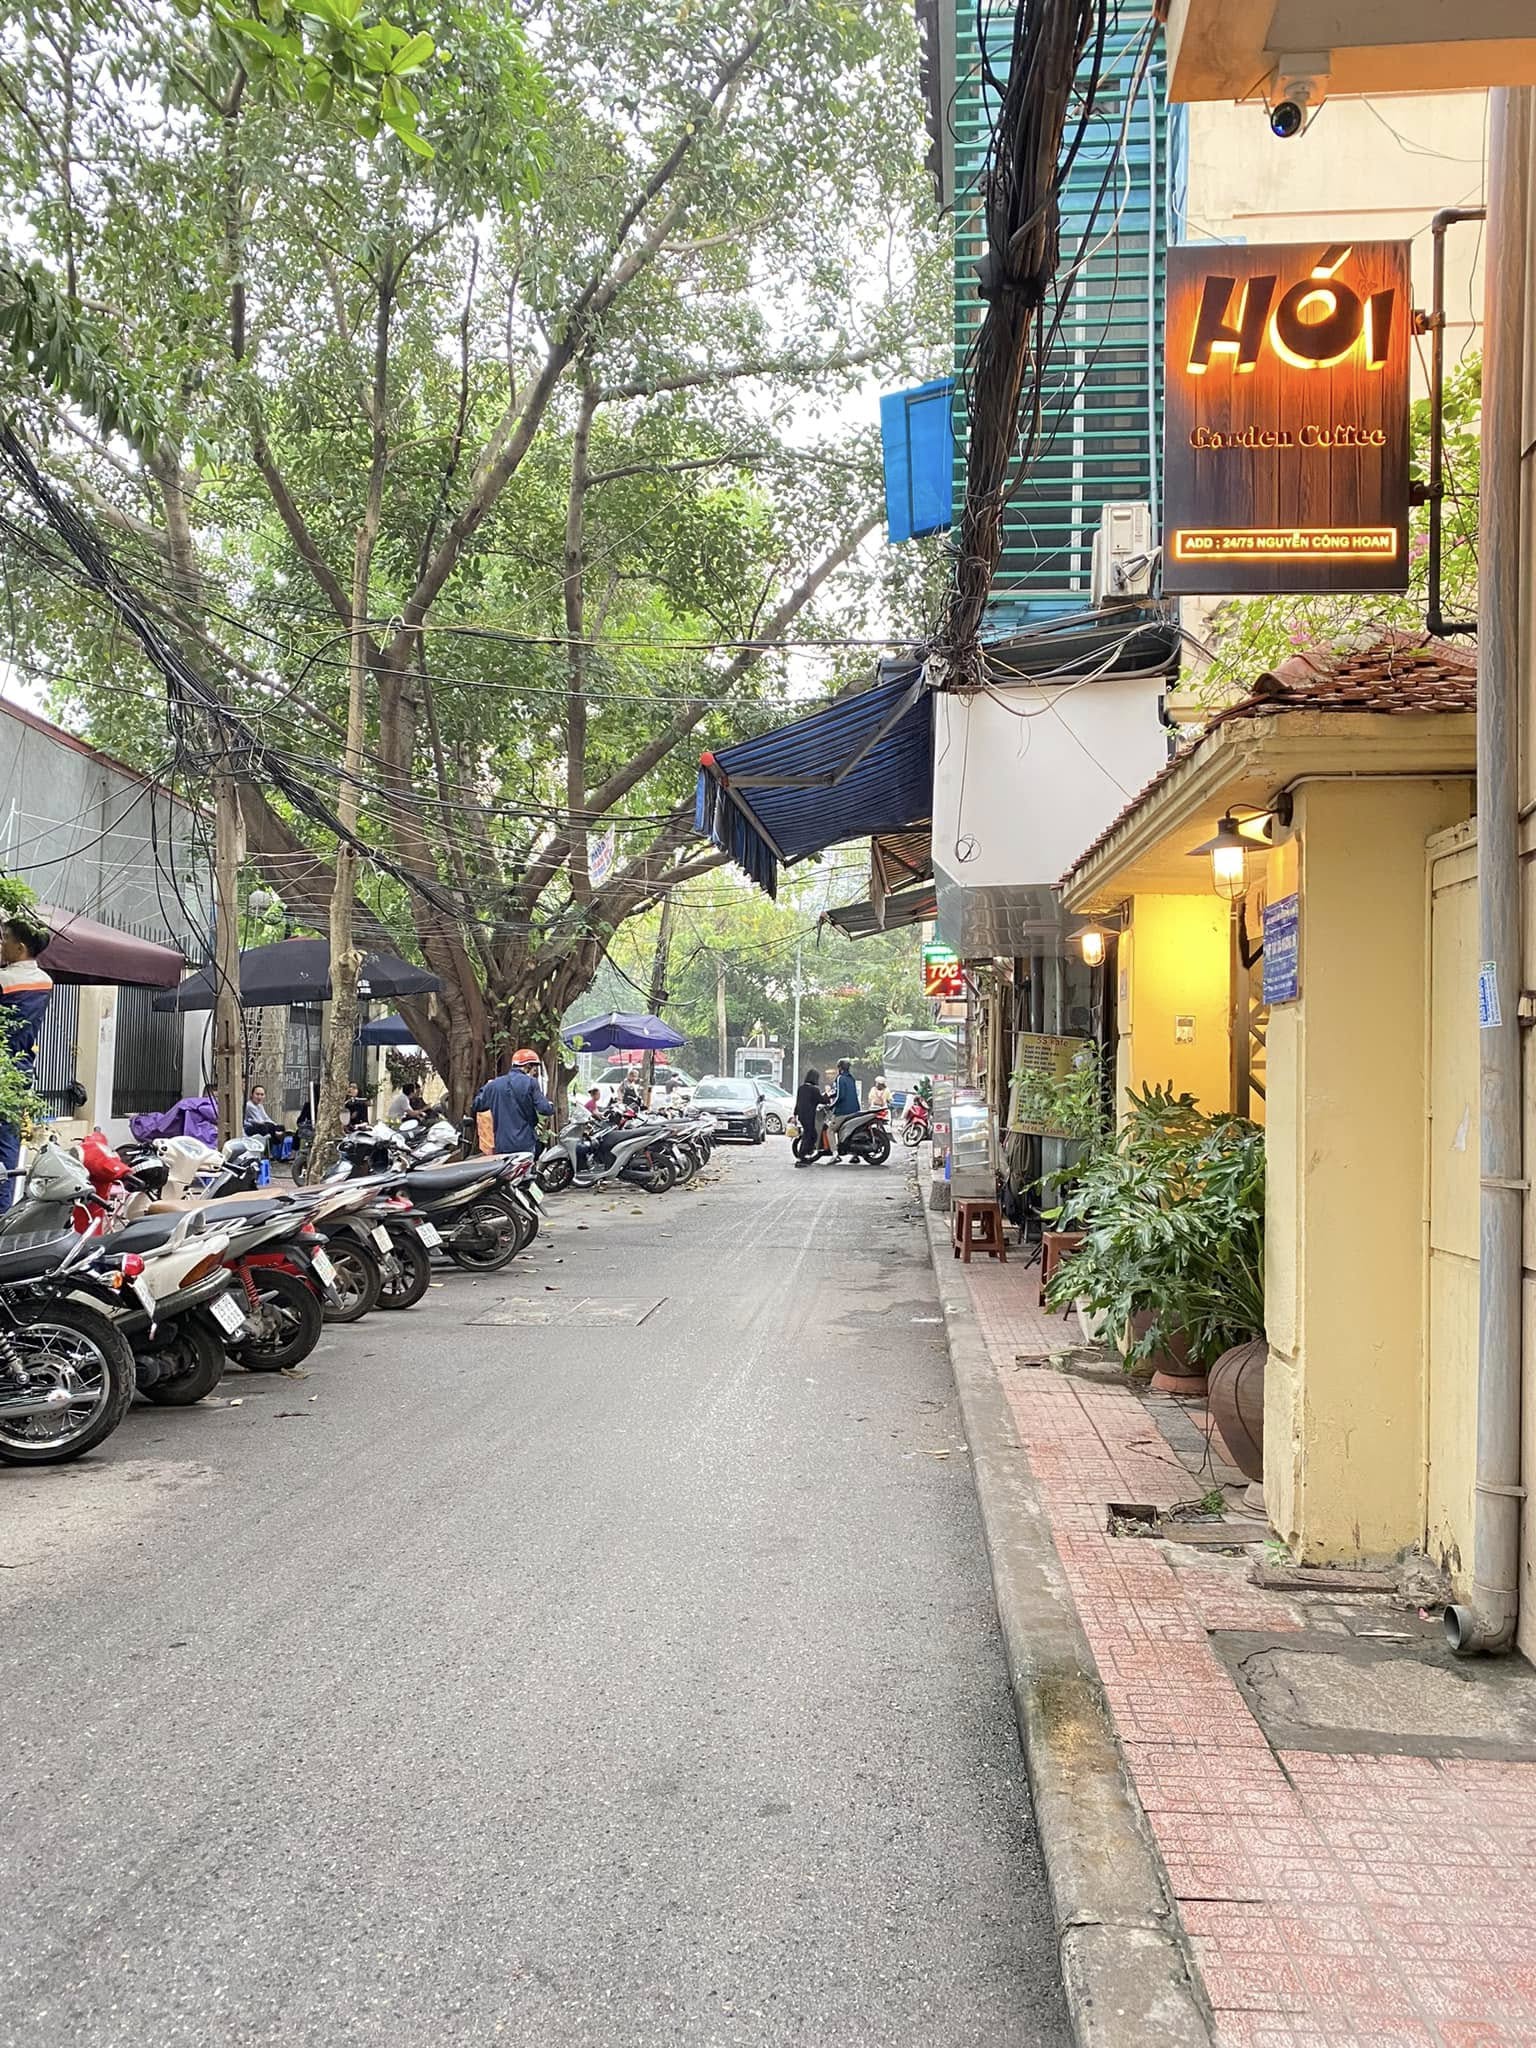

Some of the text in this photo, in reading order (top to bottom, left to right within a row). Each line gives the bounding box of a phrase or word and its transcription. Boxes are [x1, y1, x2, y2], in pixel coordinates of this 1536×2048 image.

[1189, 425, 1387, 448] Garden Coffee
[1185, 537, 1213, 549] ADD
[1222, 537, 1254, 549] 24/75
[1256, 532, 1309, 548] NGUYỄN
[1311, 534, 1349, 548] CÔNG
[1352, 536, 1390, 548] HOAN
